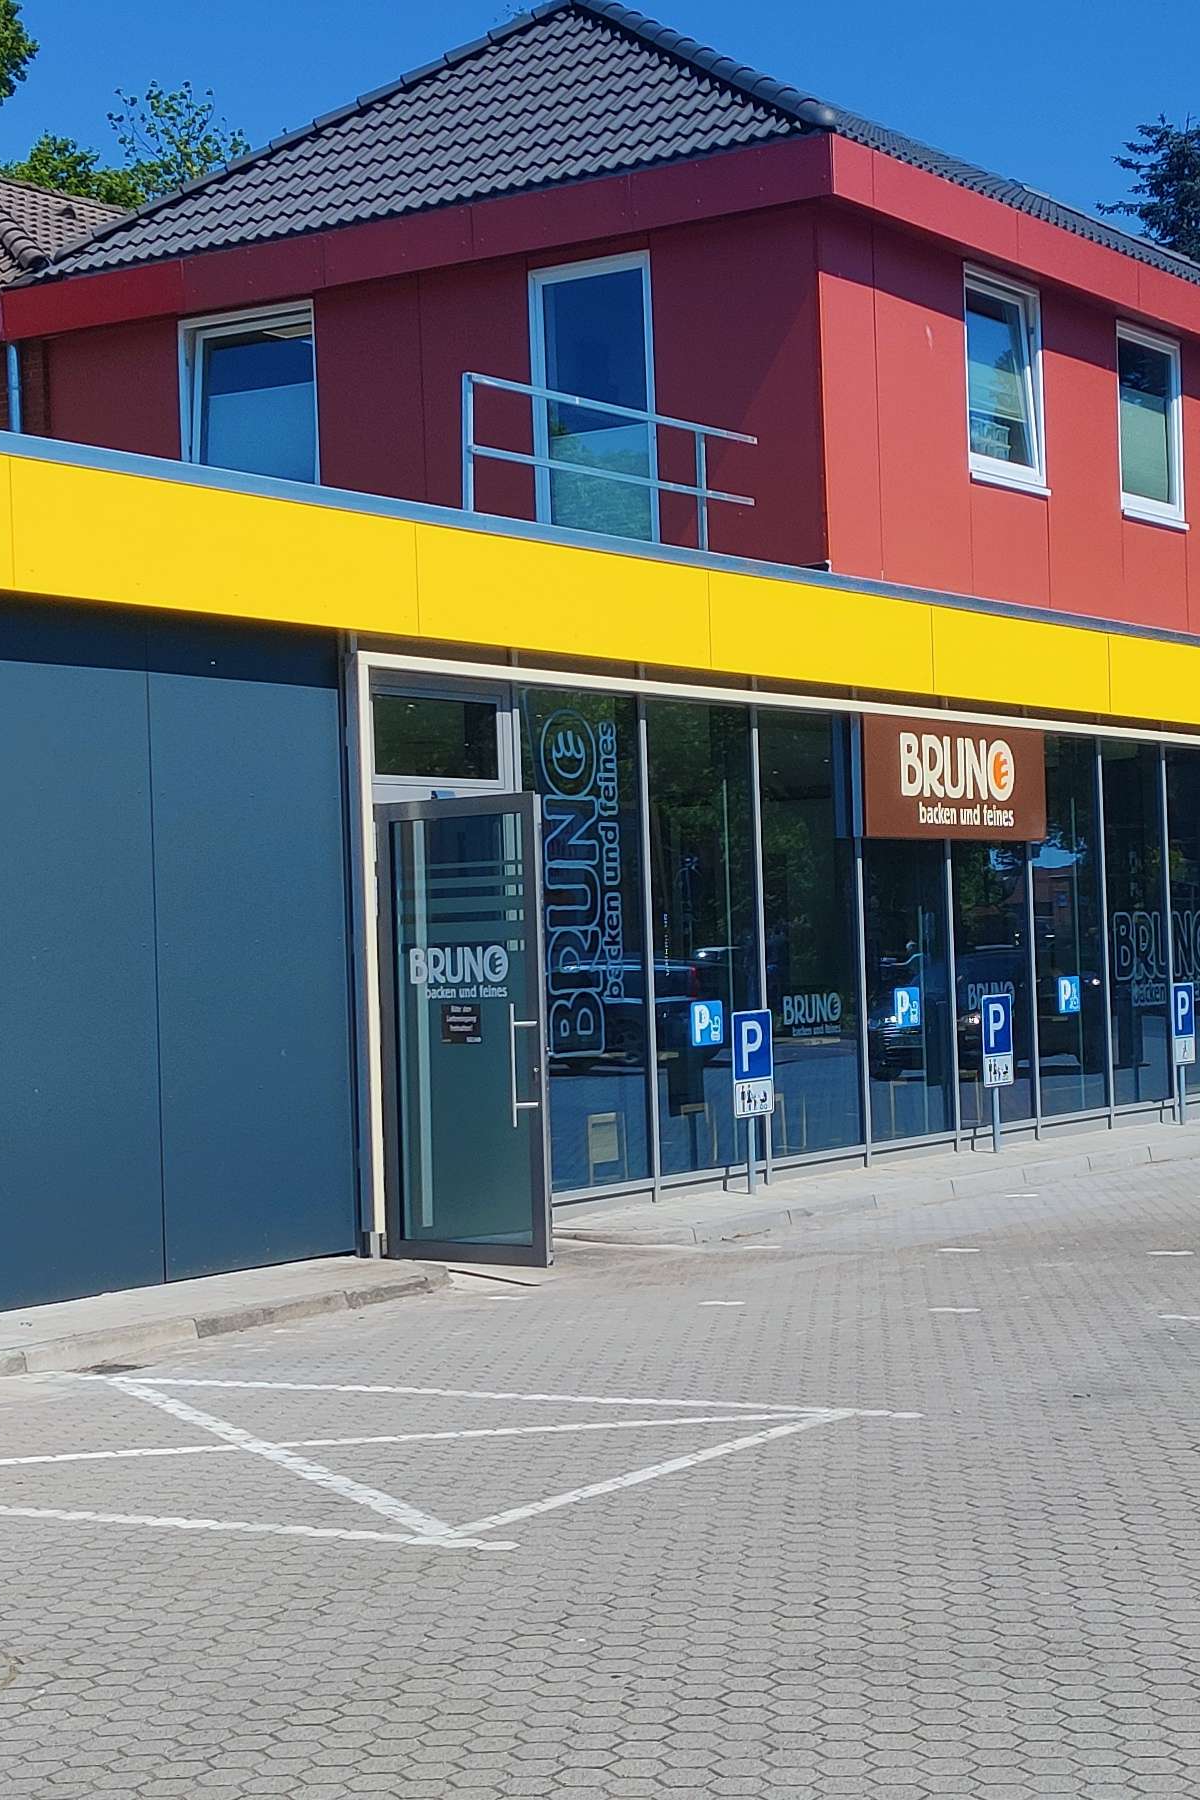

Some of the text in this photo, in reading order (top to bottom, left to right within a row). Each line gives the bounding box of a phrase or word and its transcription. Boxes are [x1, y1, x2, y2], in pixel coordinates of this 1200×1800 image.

[900, 732, 1015, 801] BRUNO
[919, 801, 1015, 827] backen und feines
[597, 720, 624, 1003] backen und feines
[541, 709, 606, 1058] BRUNO
[410, 945, 508, 984] BRUNO
[426, 984, 507, 999] backen und feines
[783, 992, 841, 1025] BRUNO
[897, 990, 910, 1026] P
[1059, 979, 1071, 1011] P
[1178, 991, 1189, 1030] P
[694, 1004, 710, 1043] P
[989, 1003, 1005, 1047] P
[742, 1020, 762, 1072] P
